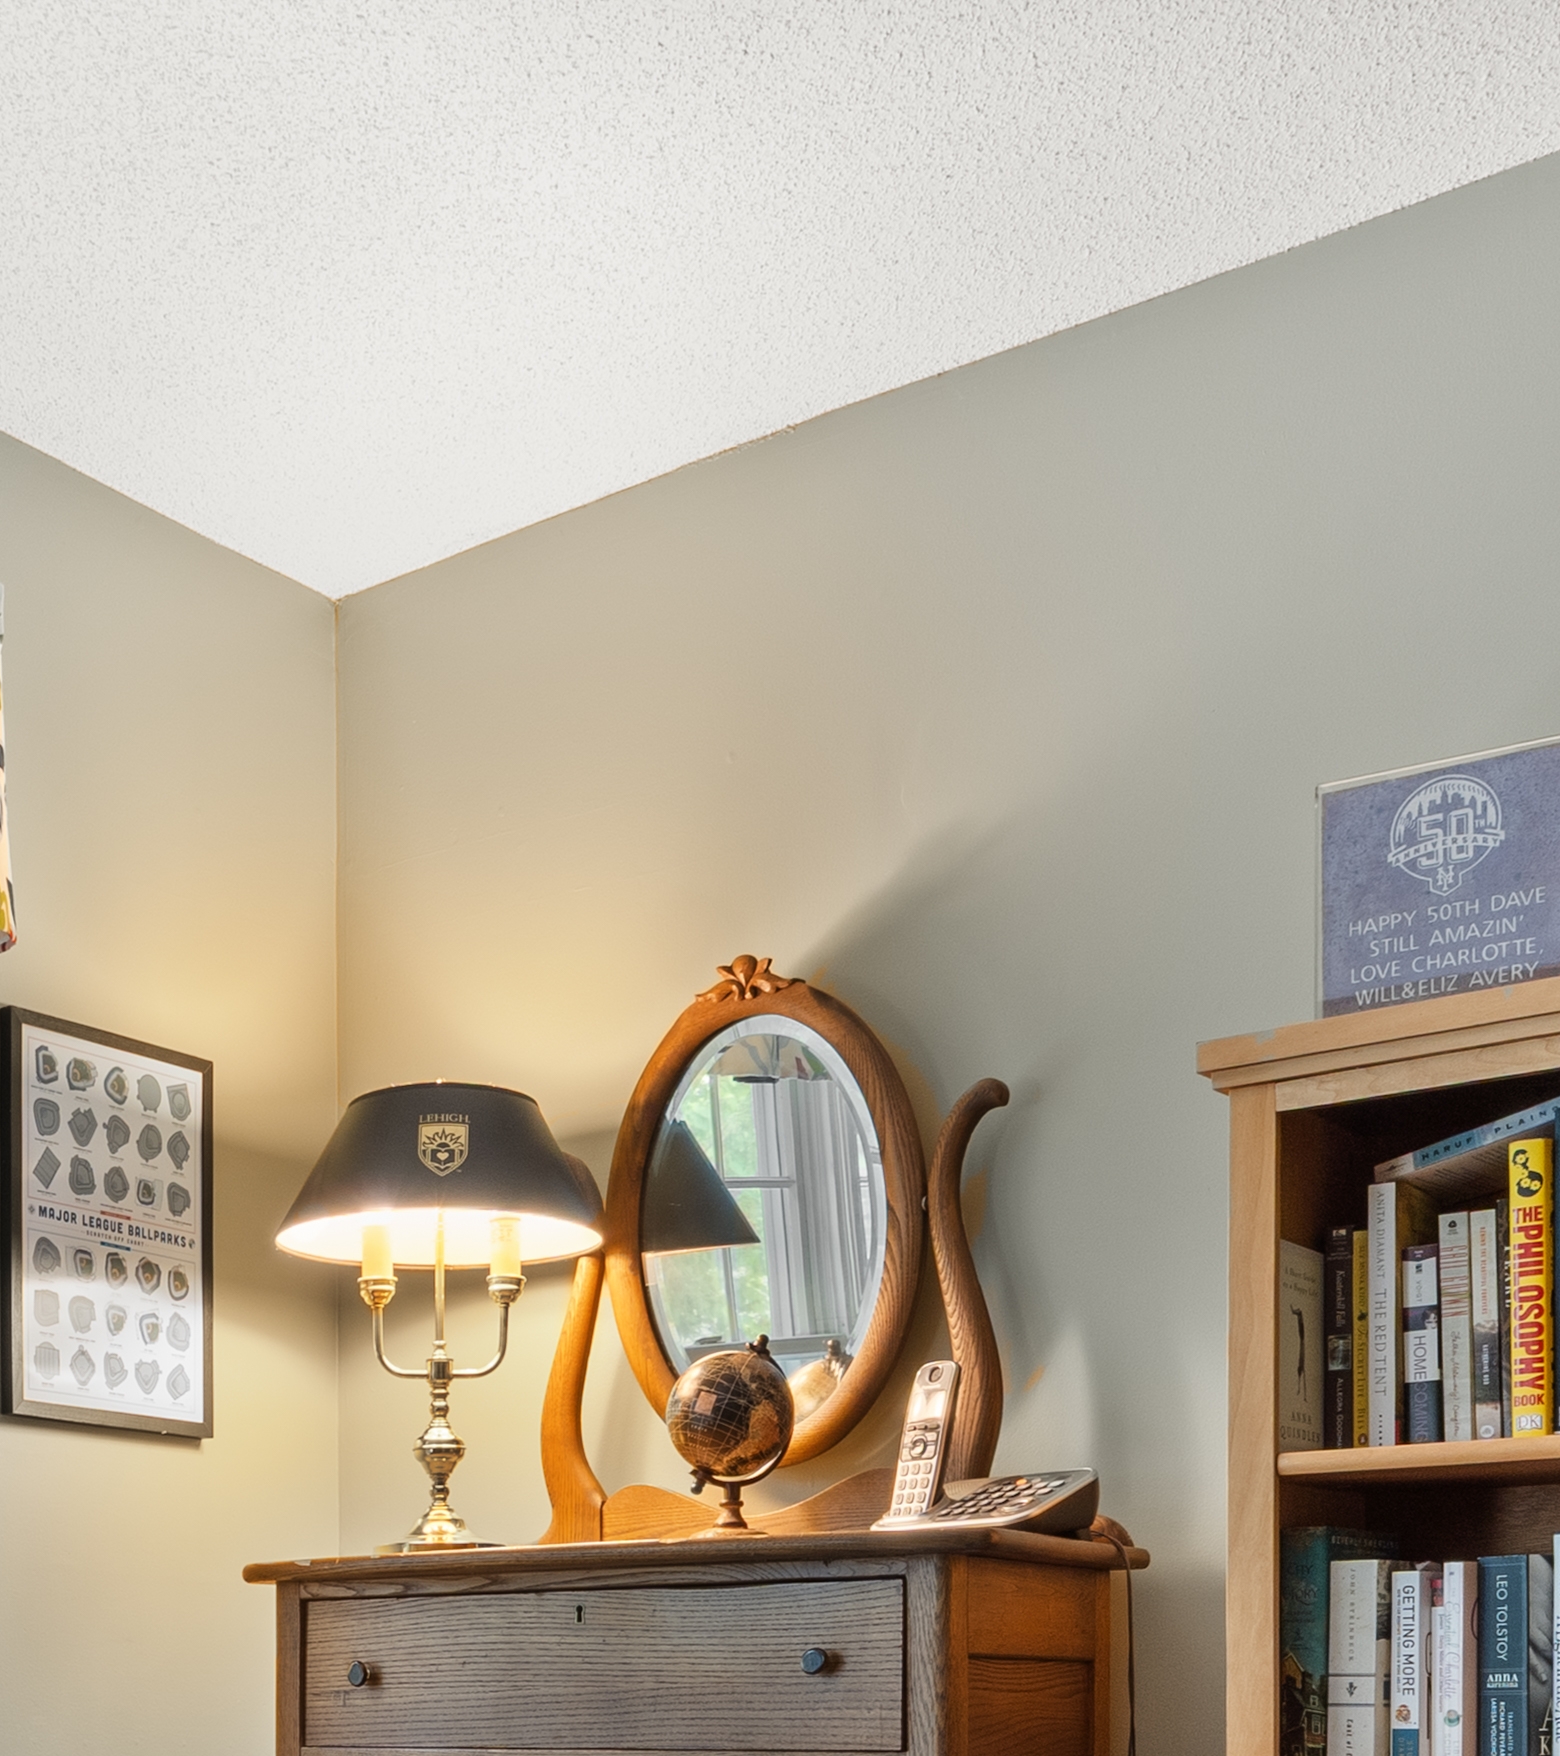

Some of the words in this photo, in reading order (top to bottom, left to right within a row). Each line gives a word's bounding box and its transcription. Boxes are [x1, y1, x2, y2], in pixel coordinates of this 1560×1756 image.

[1393, 836, 1499, 866] ANNIVERSARY
[1349, 910, 1416, 937] HAPPY
[1428, 899, 1479, 923] 50TH
[1491, 886, 1546, 911] DAVE
[1370, 935, 1419, 957] STILL
[1429, 915, 1524, 946] AMAZIN'
[1351, 961, 1401, 984] LOVE
[1412, 938, 1543, 973] CHARLOTTE,
[1355, 975, 1458, 1006] WILL&ELIZ
[1469, 962, 1539, 988] AVERY
[419, 1113, 469, 1123] LEHIGH
[1422, 1137, 1473, 1161] HARUF
[1377, 1192, 1385, 1224] ANITA
[1513, 1206, 1543, 1224] THE
[39, 1205, 77, 1224] MAJOR
[82, 1215, 123, 1234] LEAGUE
[128, 1225, 186, 1248] BALLPARKS
[1375, 1288, 1386, 1320] THE
[1512, 1226, 1545, 1392] PHILOSOPHY
[1375, 1324, 1386, 1352] RED
[1375, 1357, 1386, 1396] TENT
[1514, 1394, 1544, 1407] BOOK
[1496, 1574, 1508, 1601] LEO
[1402, 1585, 1416, 1650] GETTING
[1496, 1605, 1509, 1662] TOLSTOY
[1402, 1655, 1416, 1696] MORE
[1487, 1673, 1518, 1683] ANNA
